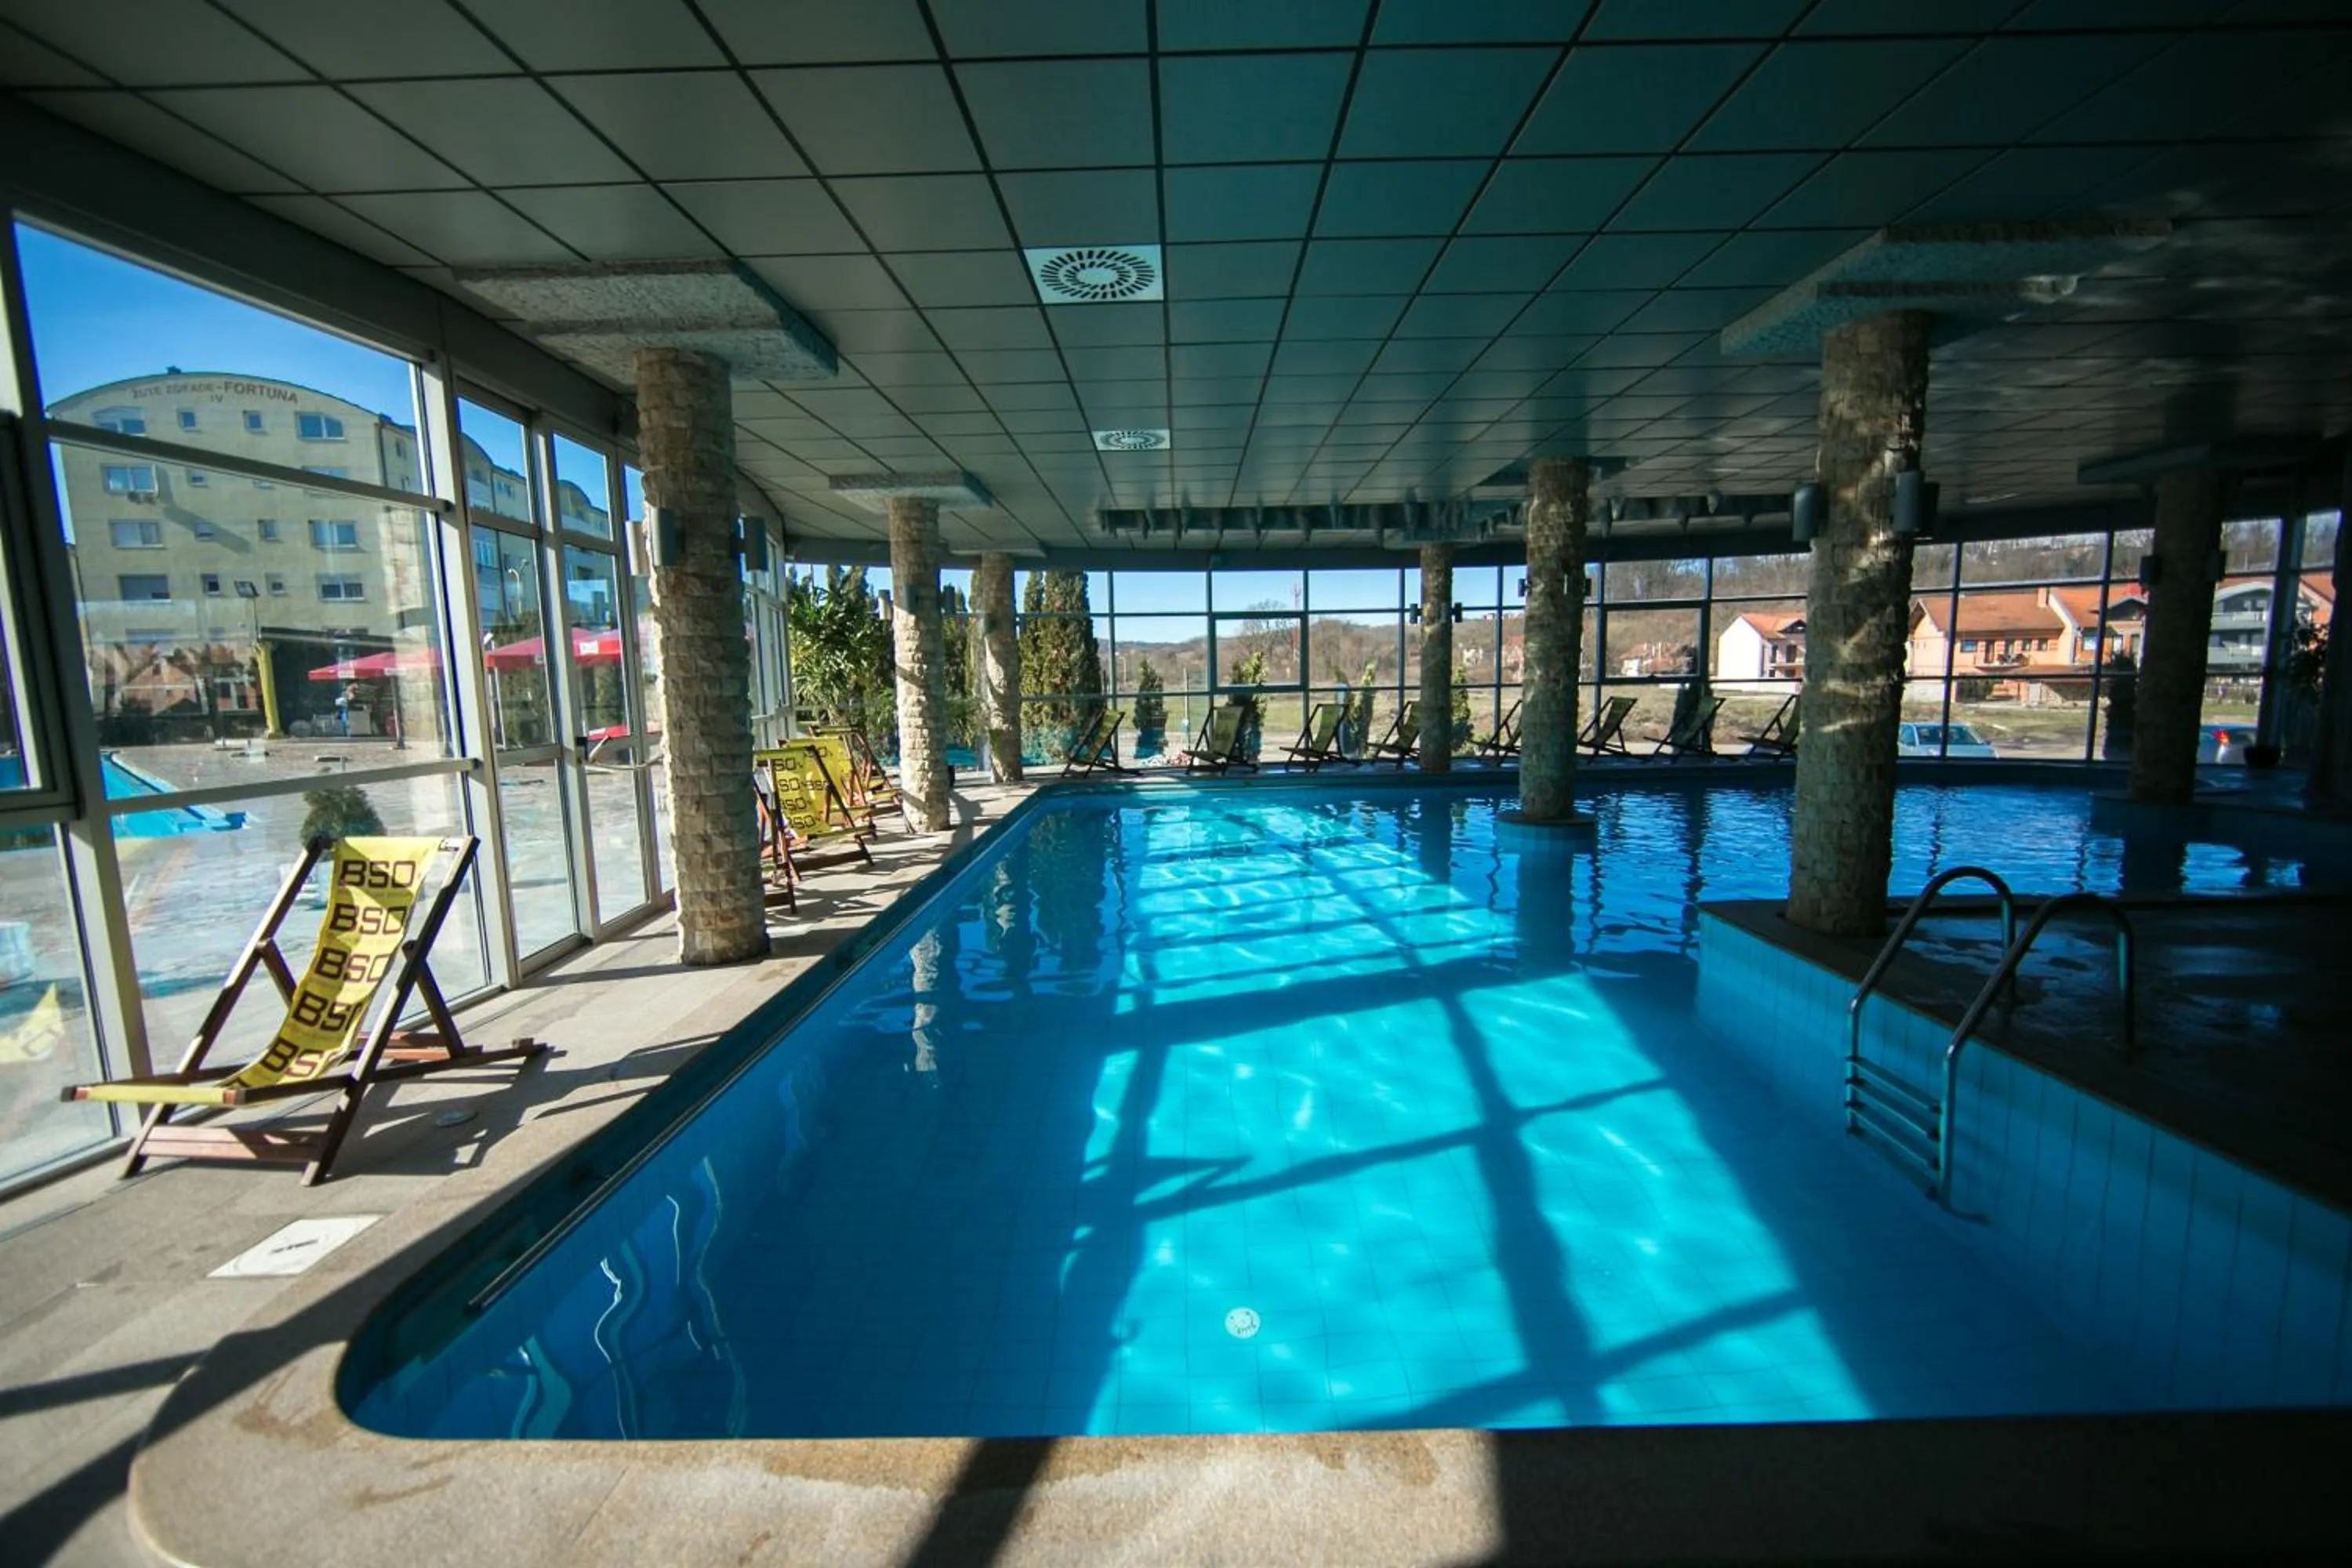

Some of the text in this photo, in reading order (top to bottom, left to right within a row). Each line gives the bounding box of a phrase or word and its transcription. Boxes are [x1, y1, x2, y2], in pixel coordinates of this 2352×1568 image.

[339, 860, 416, 888] BSO
[329, 902, 408, 935] BSO
[260, 1036, 337, 1077] BS
